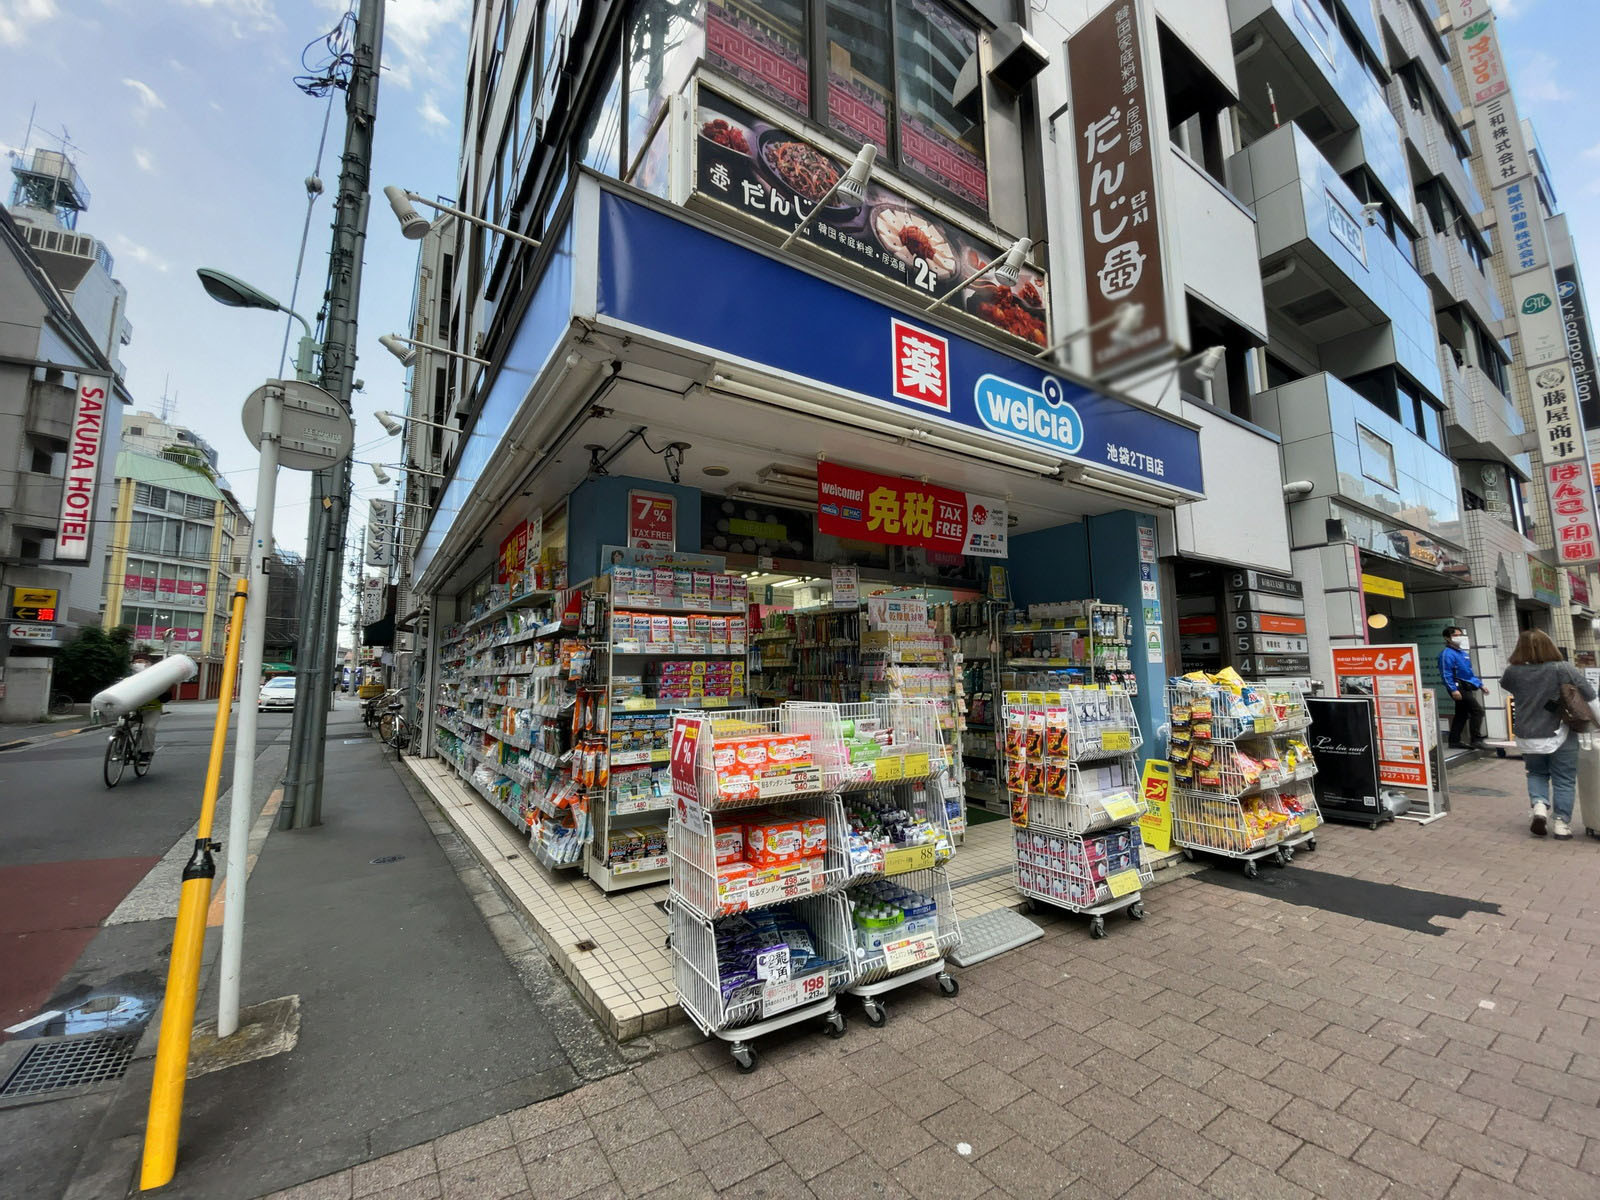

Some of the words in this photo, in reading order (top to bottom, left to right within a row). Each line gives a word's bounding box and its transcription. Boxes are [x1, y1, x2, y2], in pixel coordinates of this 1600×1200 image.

[1486, 99, 1518, 180] 三和株式会社
[1084, 105, 1130, 244] だんじ
[741, 179, 813, 221] だんじ
[1130, 190, 1149, 227] 단지
[913, 256, 938, 293] 2F
[901, 336, 943, 398] 薬
[986, 387, 1074, 446] welcia
[1542, 389, 1577, 458] 藤屋商事
[72, 386, 106, 471] SAKURA
[1106, 443, 1166, 477] 池袋2丁目店
[60, 476, 93, 547] HOTEL
[867, 486, 935, 539] 免税
[939, 505, 962, 522] TAX
[633, 528, 649, 538] TAX
[651, 530, 672, 540] FREE
[935, 521, 963, 538] FREE
[1232, 573, 1243, 588] 8
[1234, 594, 1244, 609] 7
[1236, 615, 1247, 630] 6
[1239, 637, 1250, 651] 5
[1241, 658, 1252, 673] 4
[1375, 653, 1398, 671] 6F
[794, 772, 808, 781] 478
[672, 778, 685, 792] TAX
[683, 782, 698, 799] FREE
[794, 782, 808, 791] 940
[920, 847, 933, 861] 88
[784, 876, 798, 886] 498
[784, 886, 799, 897] 980
[776, 951, 789, 984] 龍角
[802, 975, 825, 994] 198
[808, 990, 820, 1000] 213
